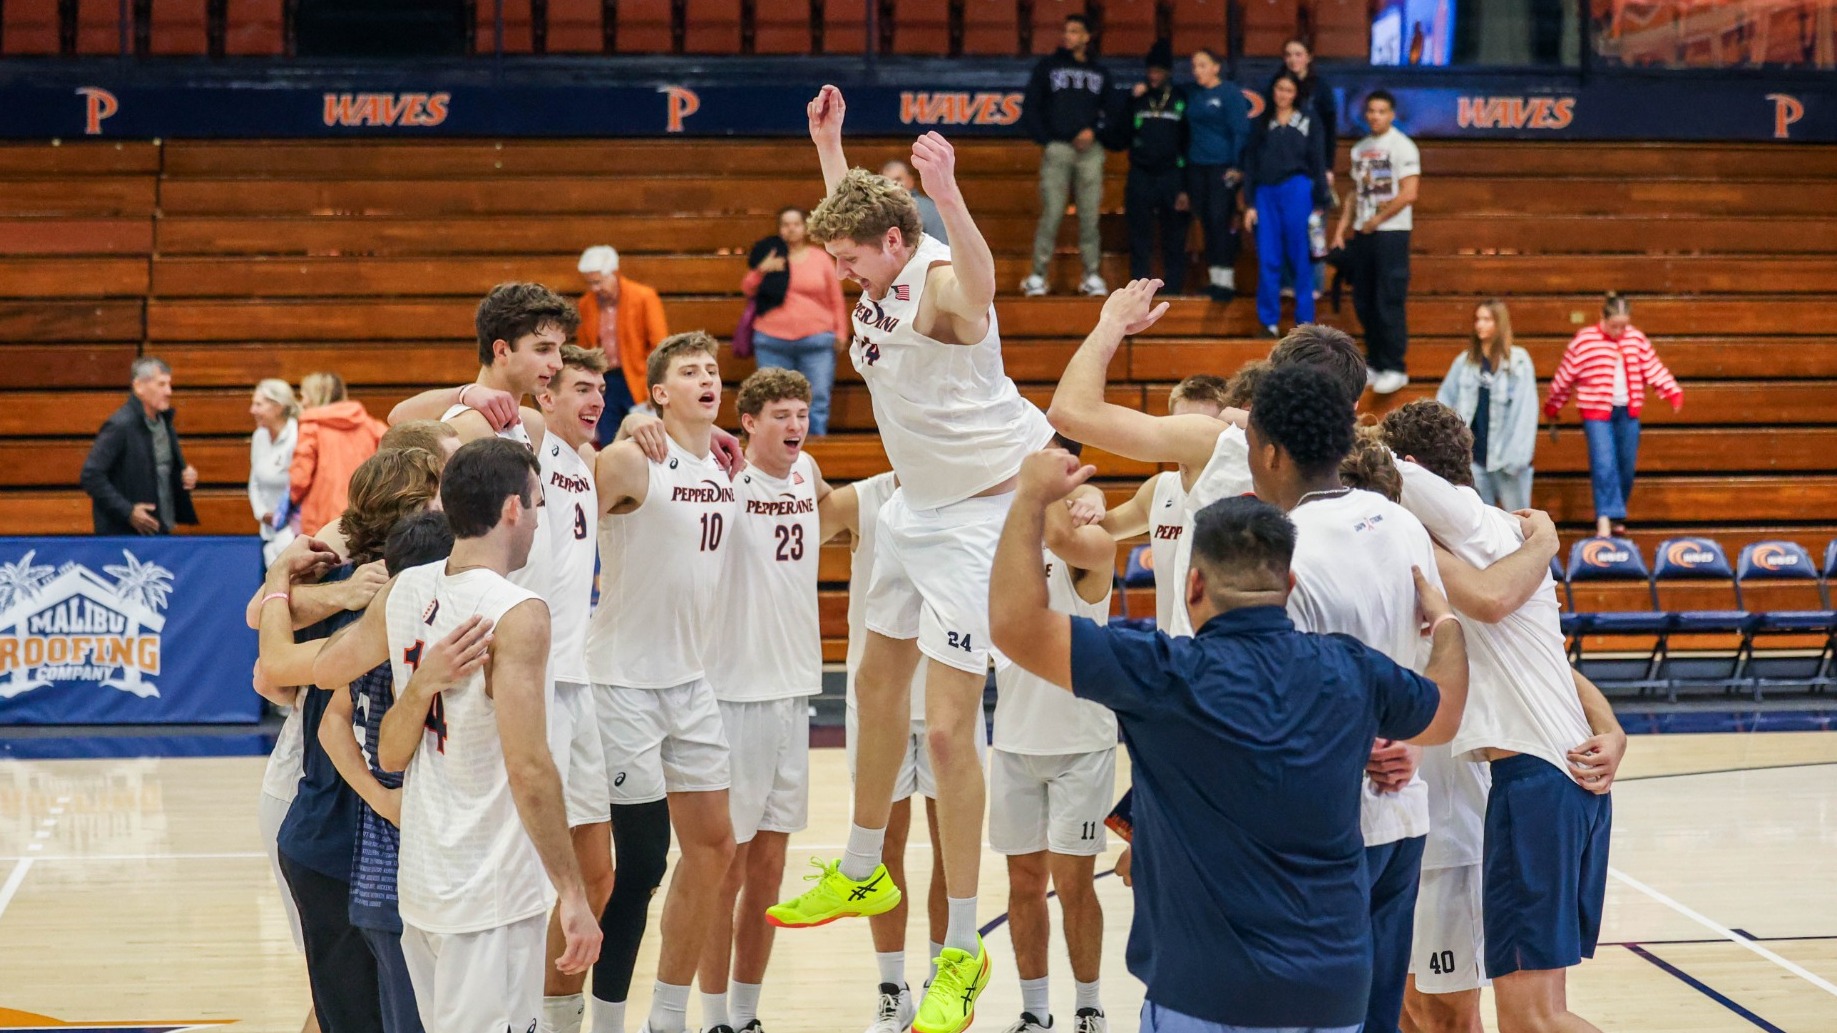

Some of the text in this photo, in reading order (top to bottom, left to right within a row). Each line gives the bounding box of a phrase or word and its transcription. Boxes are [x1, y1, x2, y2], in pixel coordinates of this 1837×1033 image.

[75, 87, 119, 134] P
[323, 93, 450, 126] WAVES
[657, 85, 700, 132] P
[900, 91, 1025, 126] WAVES
[1457, 97, 1576, 129] WAVES
[1765, 93, 1804, 138] P
[574, 502, 587, 540] 9
[700, 512, 723, 552] 10
[775, 523, 804, 561] 23
[30, 596, 126, 633] MALIBU
[0, 636, 160, 675] ROOFING
[947, 630, 972, 652] 24
[36, 665, 114, 682] COMPANY
[1081, 821, 1096, 840] 11
[1430, 950, 1455, 974] 40
